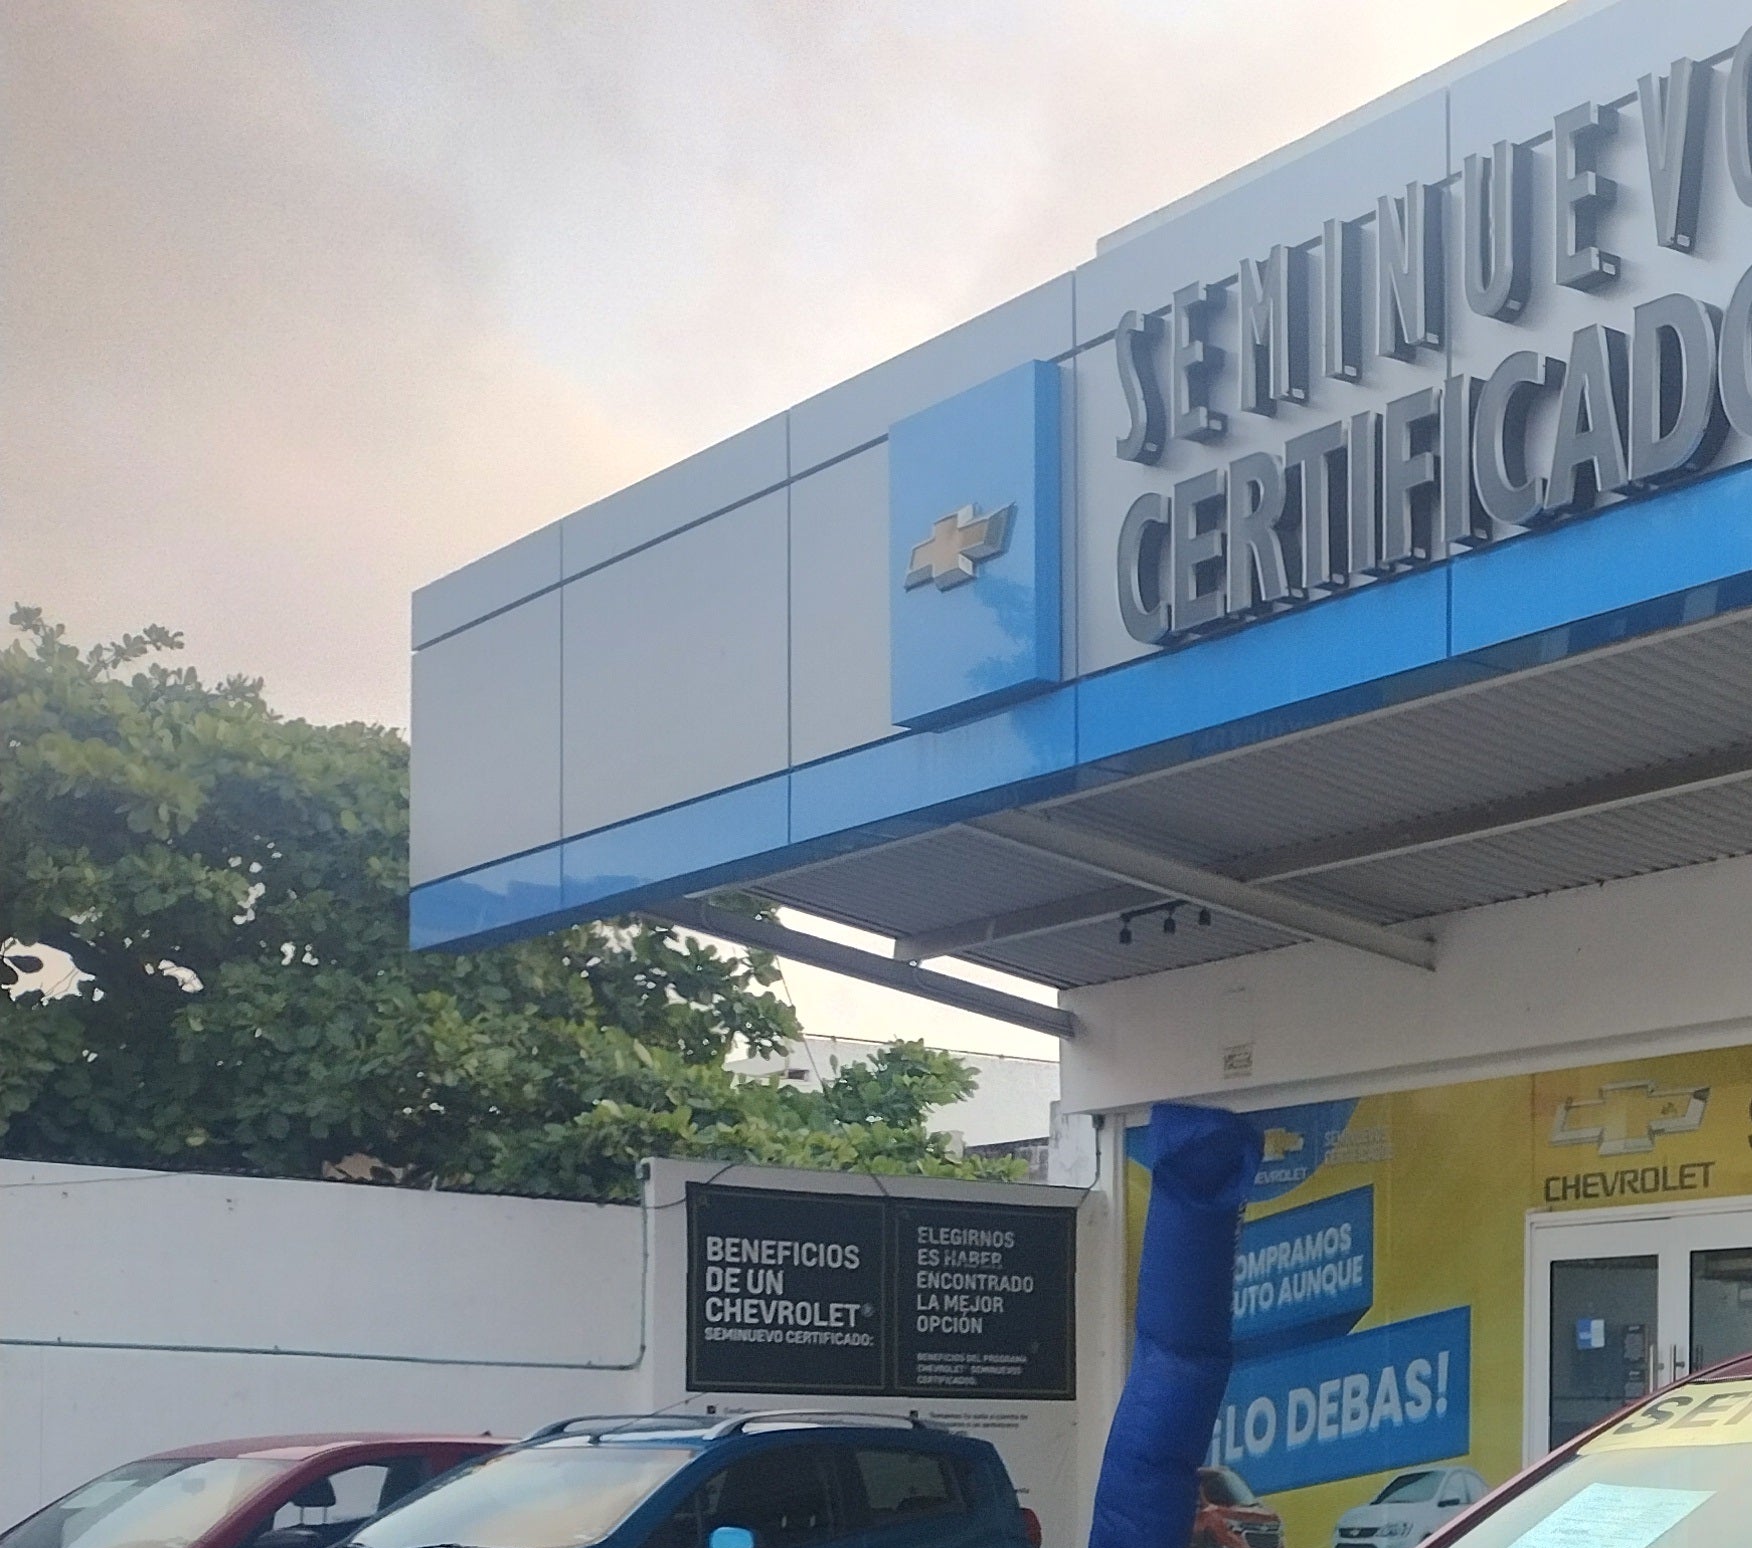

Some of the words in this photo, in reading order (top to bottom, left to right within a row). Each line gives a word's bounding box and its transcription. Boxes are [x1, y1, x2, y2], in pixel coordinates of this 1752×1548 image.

[1544, 1160, 1715, 1203] CHEVROLET
[917, 1226, 1015, 1249] ELEGIRNOS
[705, 1236, 861, 1269] BENEFICIOS
[917, 1248, 940, 1267] ES
[944, 1249, 1004, 1269] HABER
[1233, 1222, 1353, 1283] OMPRAMOS
[705, 1266, 742, 1294] DE
[746, 1268, 785, 1296] UN
[916, 1270, 1034, 1293] ENCONTRADO
[1232, 1281, 1275, 1318] UTO
[1277, 1253, 1365, 1306] AUNQUE
[916, 1293, 940, 1311] LA
[943, 1294, 1004, 1313] MEJOR
[703, 1326, 784, 1343] SEMINUEVO
[916, 1311, 983, 1334] OPCIÓN
[1286, 1350, 1449, 1450] DEBAS!
